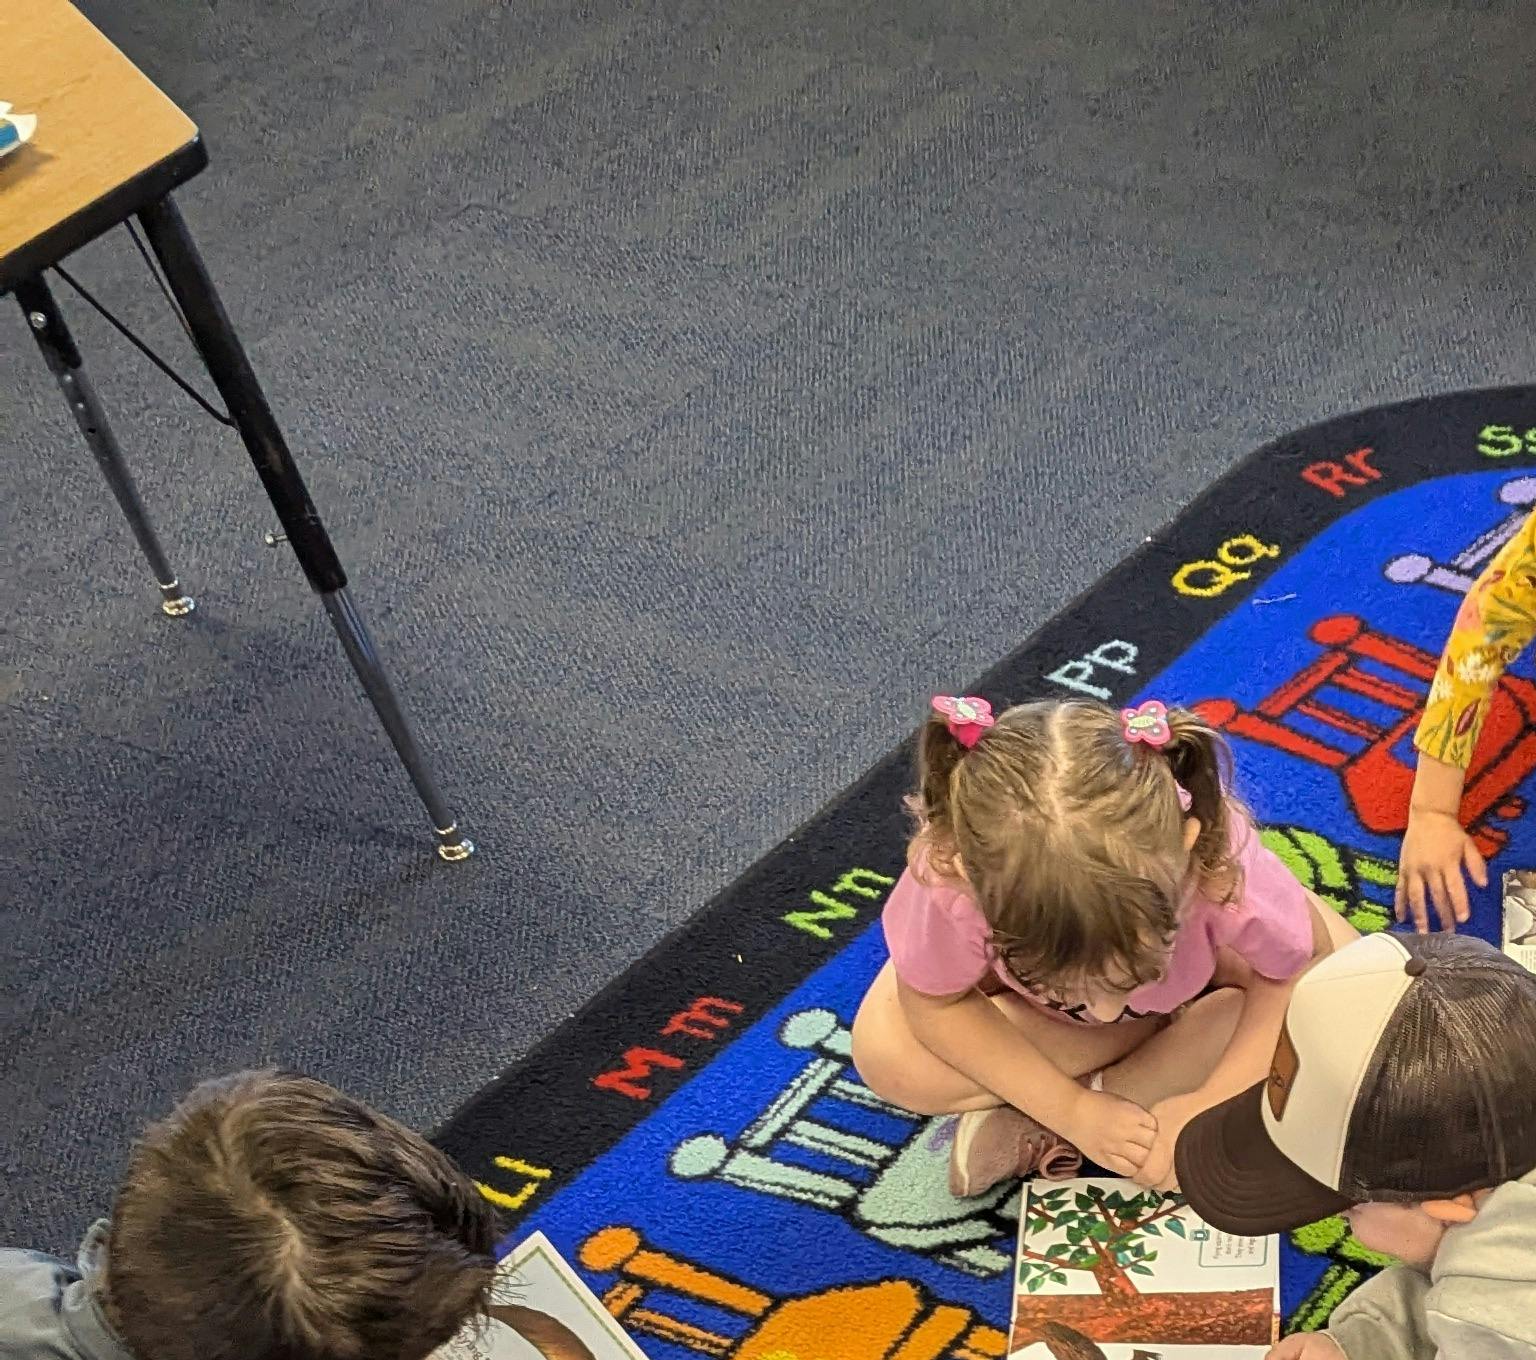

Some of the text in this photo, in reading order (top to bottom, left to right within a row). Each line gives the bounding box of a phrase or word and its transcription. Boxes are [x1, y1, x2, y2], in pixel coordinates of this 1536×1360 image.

[1302, 447, 1382, 497] Rr
[1171, 534, 1281, 598] Qq
[1045, 638, 1140, 700] Pp
[784, 868, 890, 939] Nn
